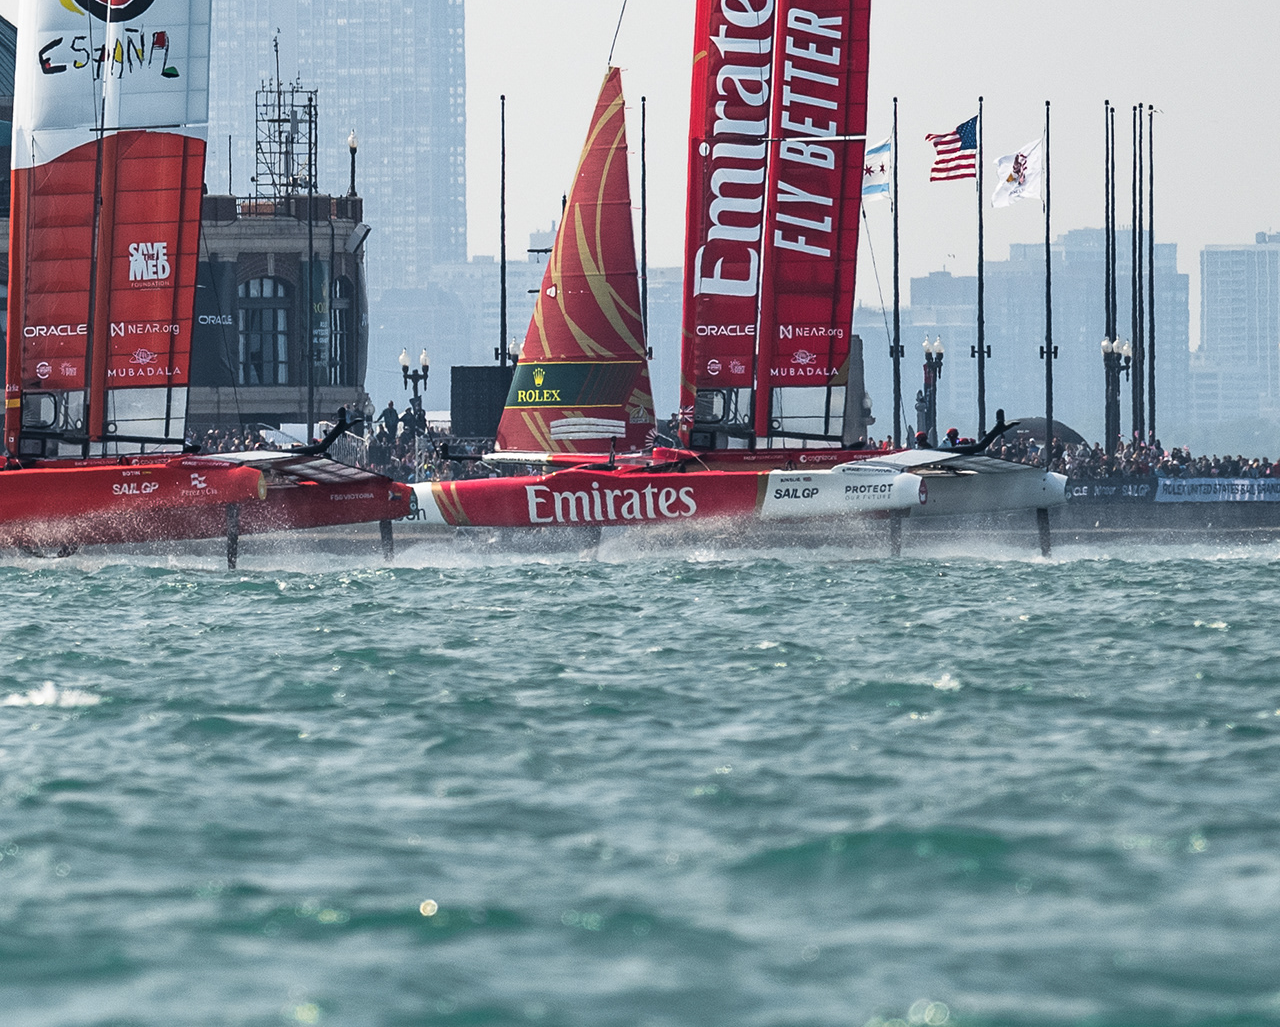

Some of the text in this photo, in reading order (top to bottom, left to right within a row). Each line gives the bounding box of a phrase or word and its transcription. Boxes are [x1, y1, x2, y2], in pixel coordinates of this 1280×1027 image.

[773, 7, 843, 258] FLY BETTER
[128, 242, 168, 262] SAVE
[144, 253, 156, 261] THE
[128, 260, 171, 281] MED
[131, 280, 170, 288] FOUNDATION
[198, 315, 233, 325] ORACLE
[23, 324, 88, 337] ORACLE
[128, 324, 180, 334] NEAR.org
[696, 325, 755, 336] ORACLE
[795, 327, 843, 338] NEAR.org
[107, 367, 181, 378] MUBADALA
[770, 367, 839, 377] MUBADALA
[518, 389, 561, 403] ROLEX
[112, 481, 159, 495] SAIL GP
[845, 483, 893, 494] PROTECT
[525, 482, 697, 523] Emirates
